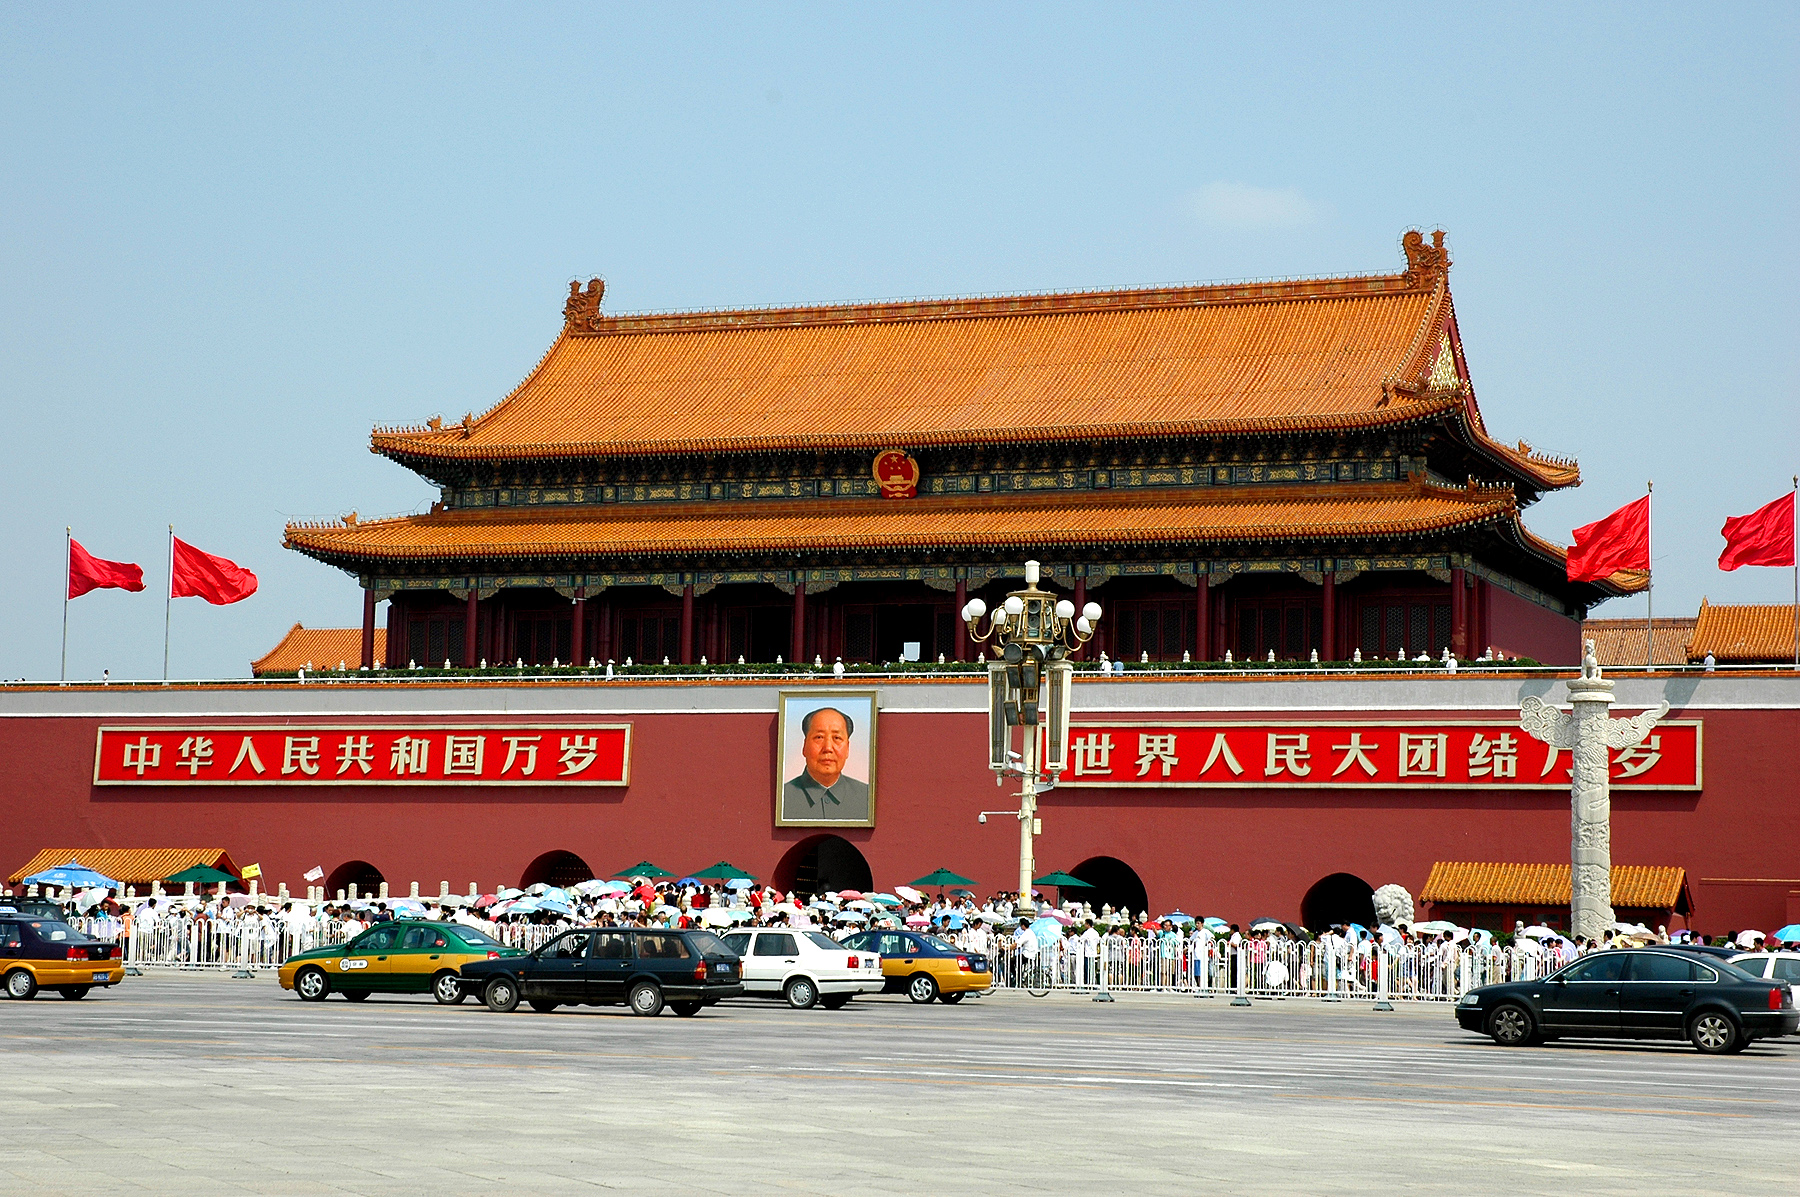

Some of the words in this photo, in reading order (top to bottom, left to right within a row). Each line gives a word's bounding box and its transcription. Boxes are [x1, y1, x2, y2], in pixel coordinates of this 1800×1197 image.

[121, 734, 600, 776] 中华人民共和国万岁
